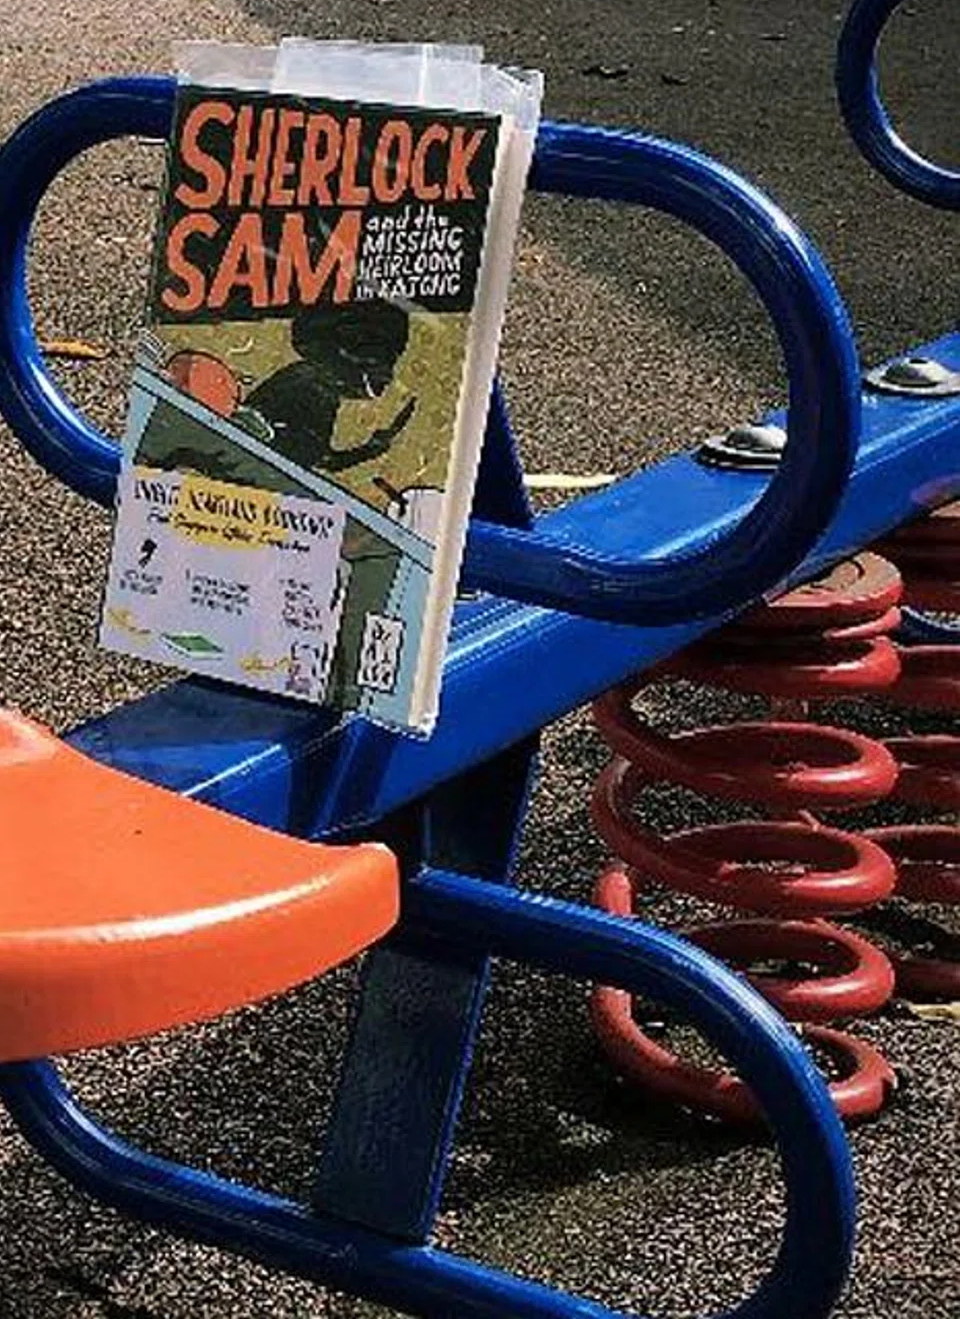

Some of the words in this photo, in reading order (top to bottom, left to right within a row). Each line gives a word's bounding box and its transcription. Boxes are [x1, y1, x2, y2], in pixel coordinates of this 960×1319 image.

[174, 99, 487, 210] SHERLOCK
[366, 204, 410, 232] and
[414, 204, 449, 230] the
[362, 226, 464, 257] MISSING
[160, 209, 363, 314] SAM
[358, 249, 464, 282] HEIRLOOM
